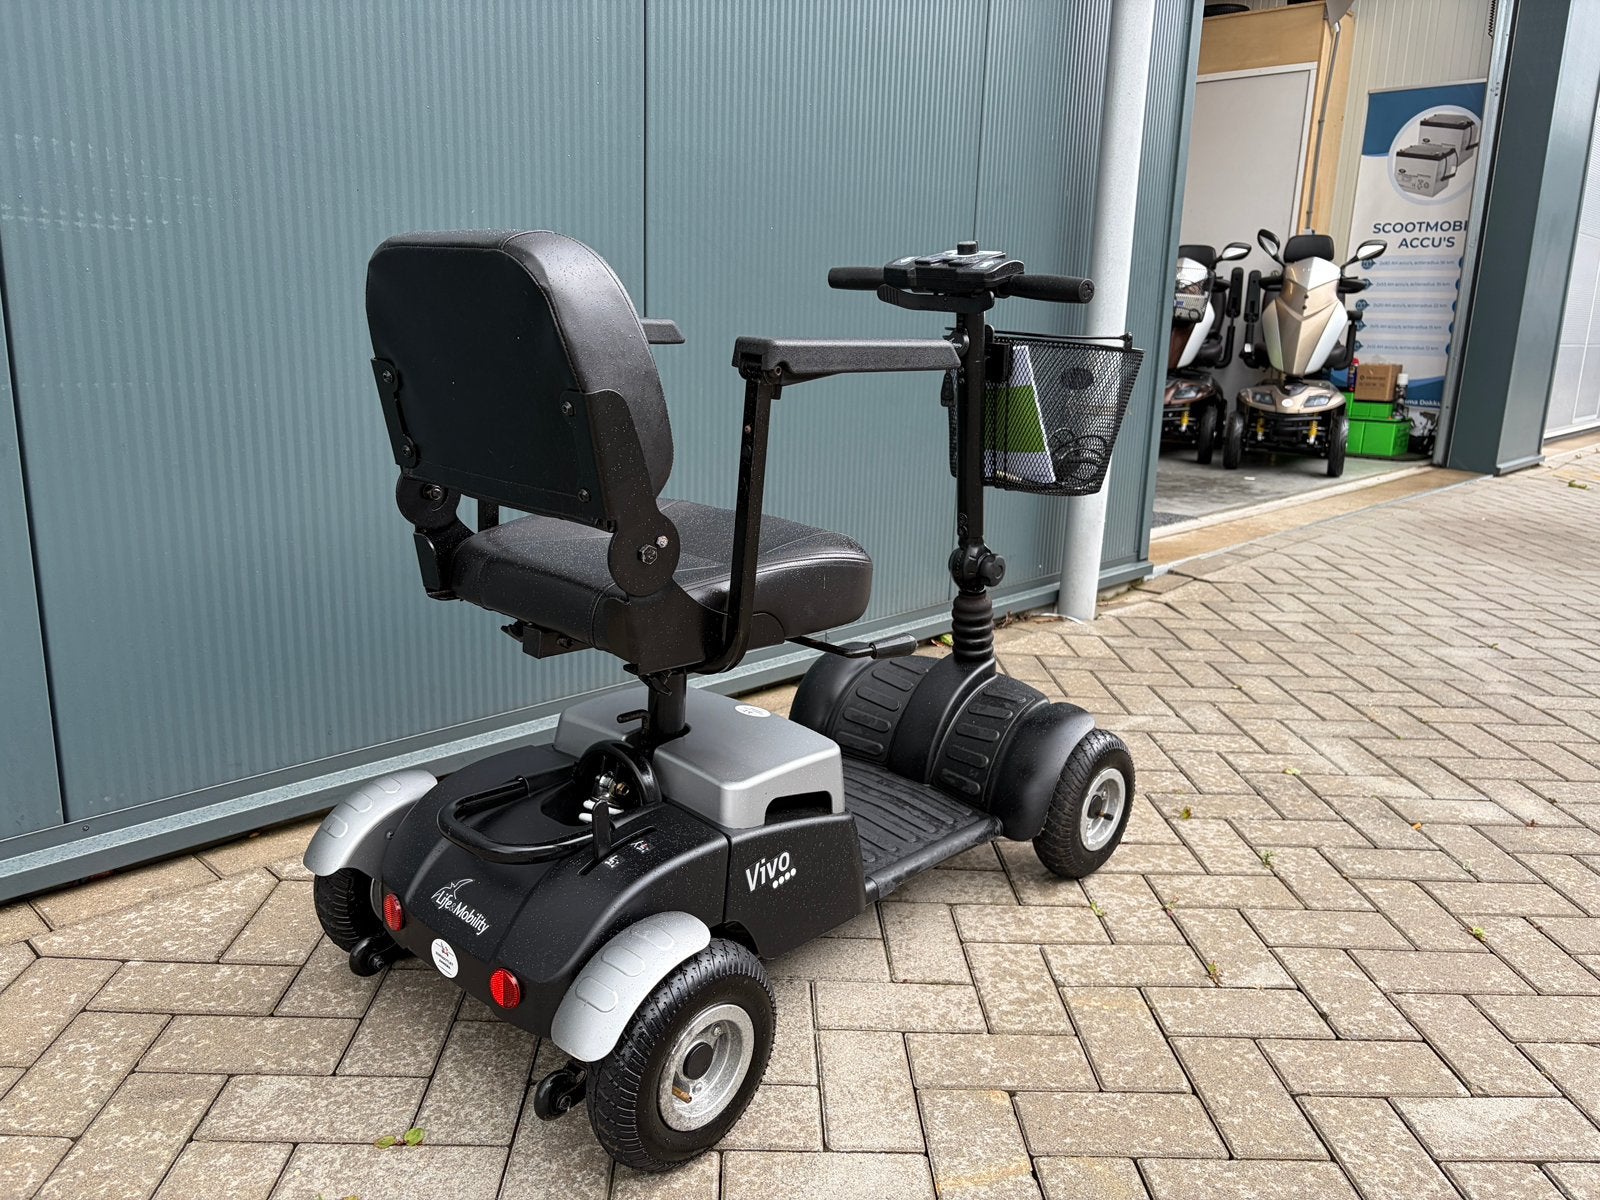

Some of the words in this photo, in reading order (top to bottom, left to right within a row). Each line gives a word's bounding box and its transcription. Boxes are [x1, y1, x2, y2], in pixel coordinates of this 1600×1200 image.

[1373, 220, 1468, 234] SCOOTMOBI
[1398, 236, 1456, 249] ACCU'S
[745, 852, 790, 892] Vivo
[435, 890, 490, 936] Life&Mobility
